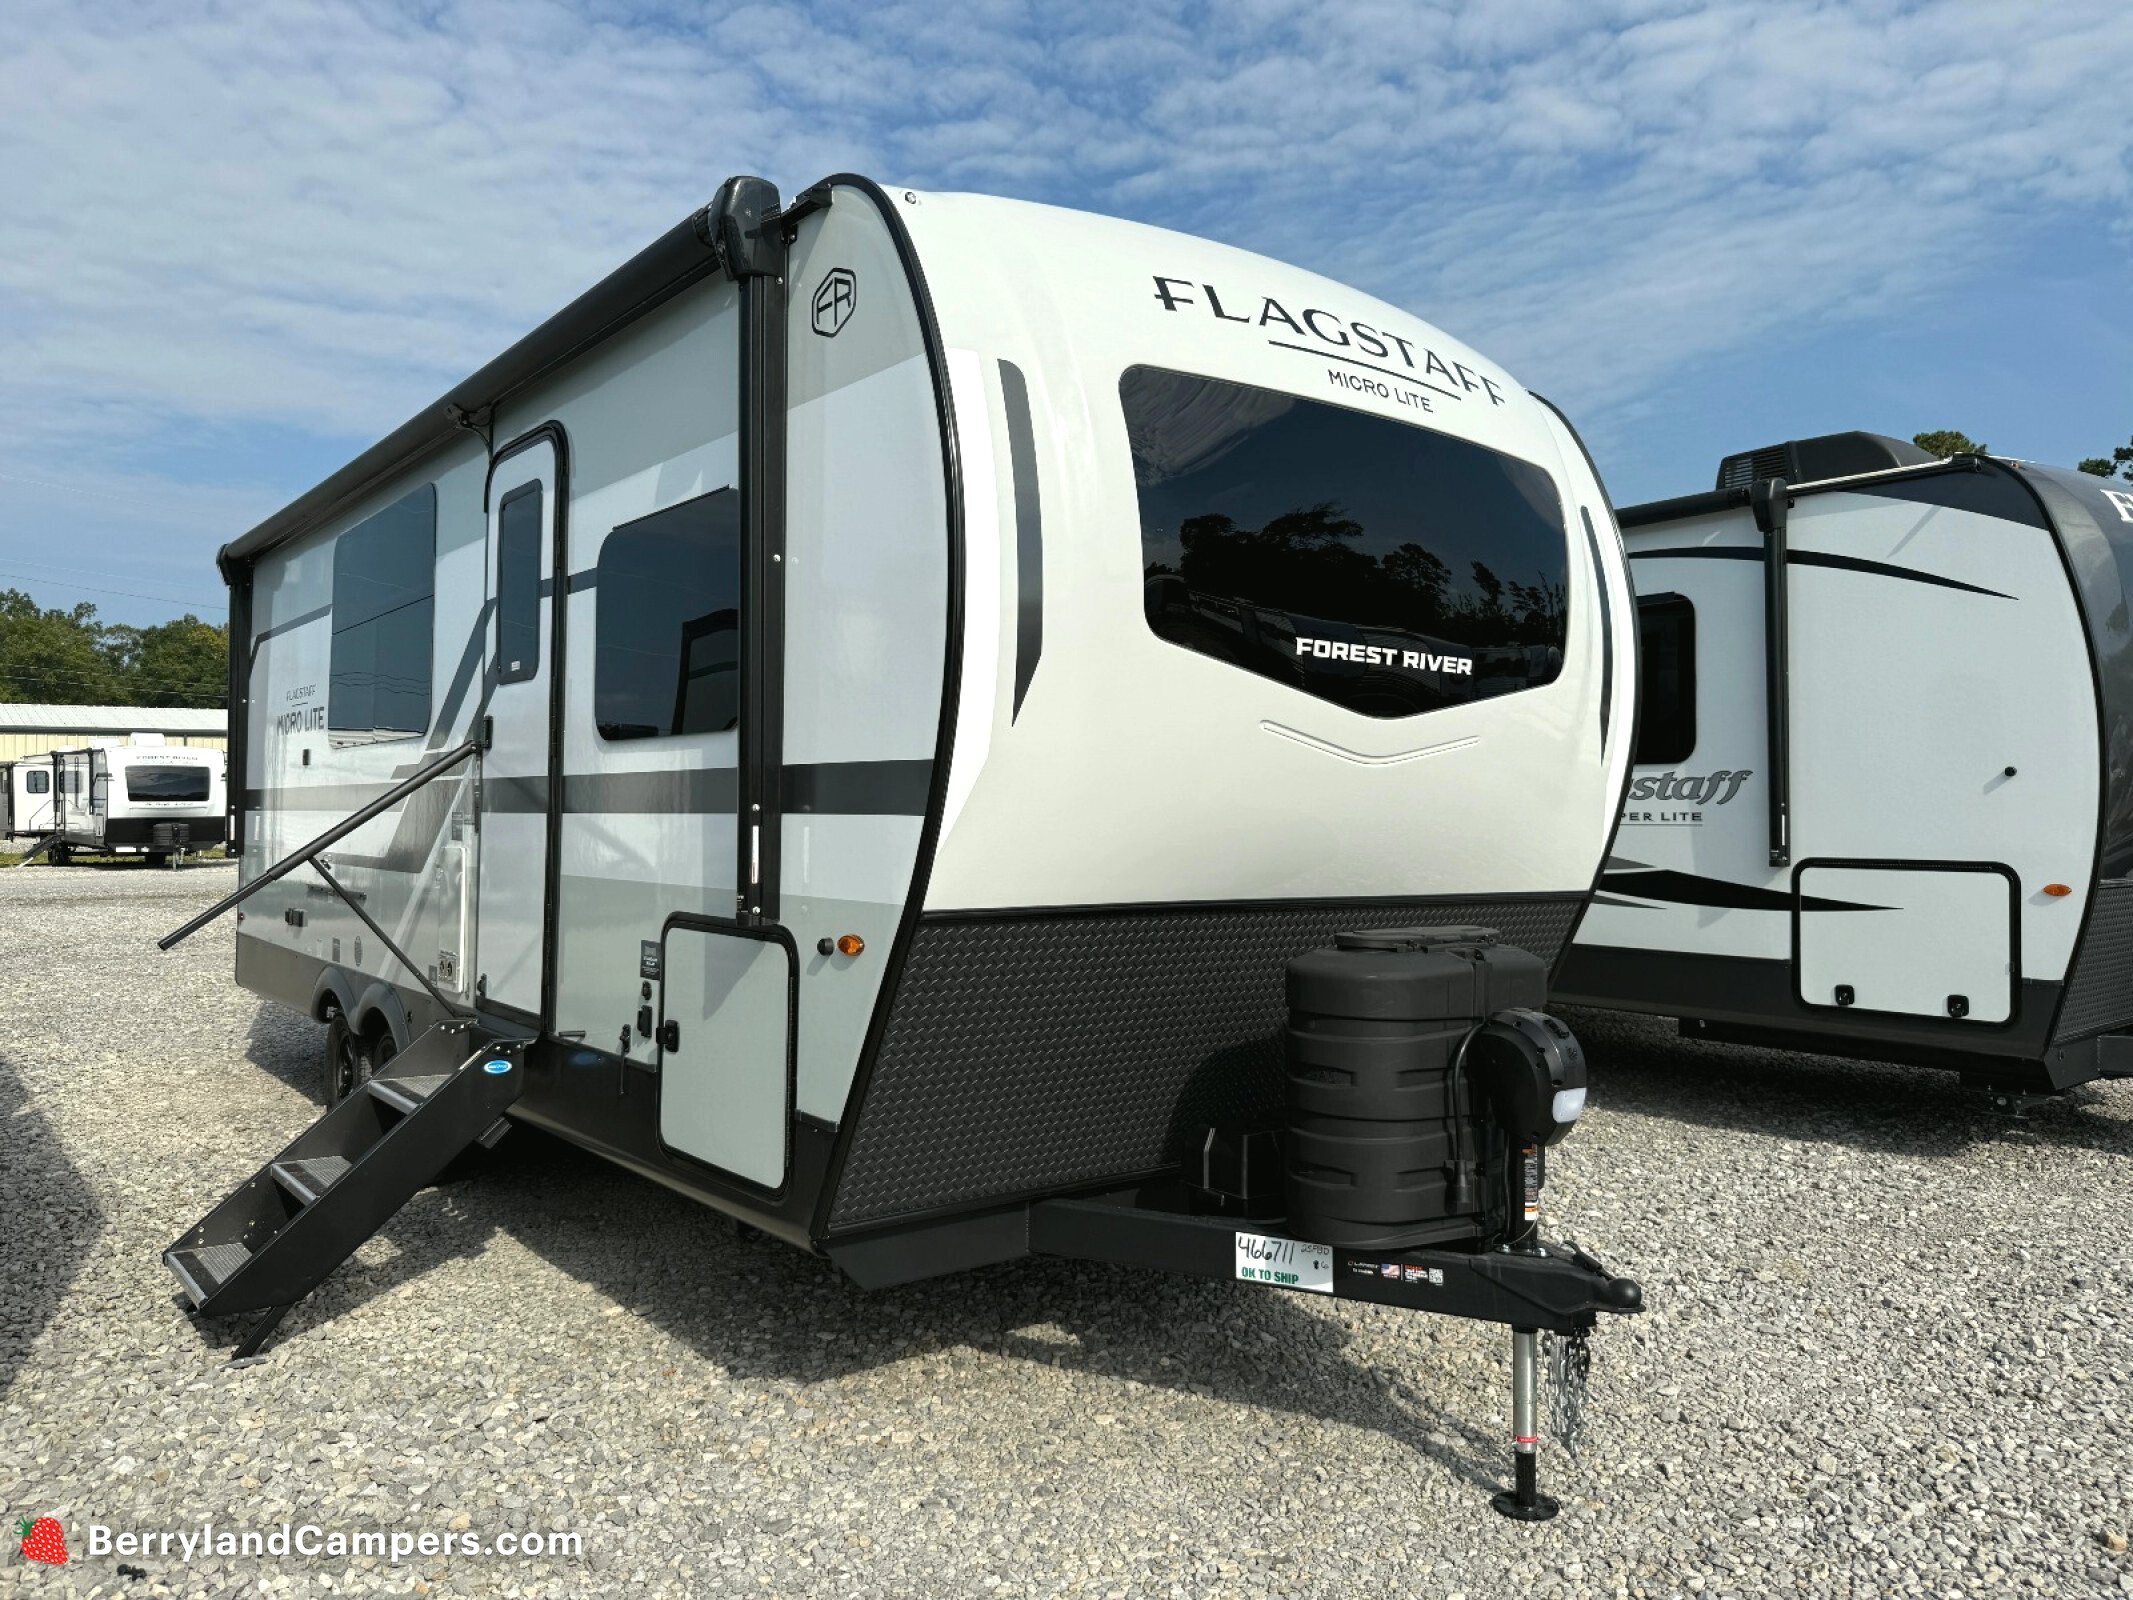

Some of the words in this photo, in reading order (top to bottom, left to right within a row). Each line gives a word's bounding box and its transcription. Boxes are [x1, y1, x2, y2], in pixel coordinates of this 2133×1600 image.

[1153, 275, 1506, 407] FLAGSTAFF
[1328, 368, 1389, 399] MICRO
[1395, 386, 1434, 414] LITE
[1295, 636, 1398, 666] FOREST
[1402, 650, 1473, 675] RIVER
[276, 710, 302, 737] MICRO
[304, 706, 325, 733] LITE
[1628, 769, 1754, 805] staff
[1660, 812, 1703, 821] LITE
[1238, 1236, 1295, 1265] 466711
[1242, 1266, 1256, 1279] OK
[1258, 1268, 1271, 1281] TO
[1274, 1271, 1299, 1285] SHIP
